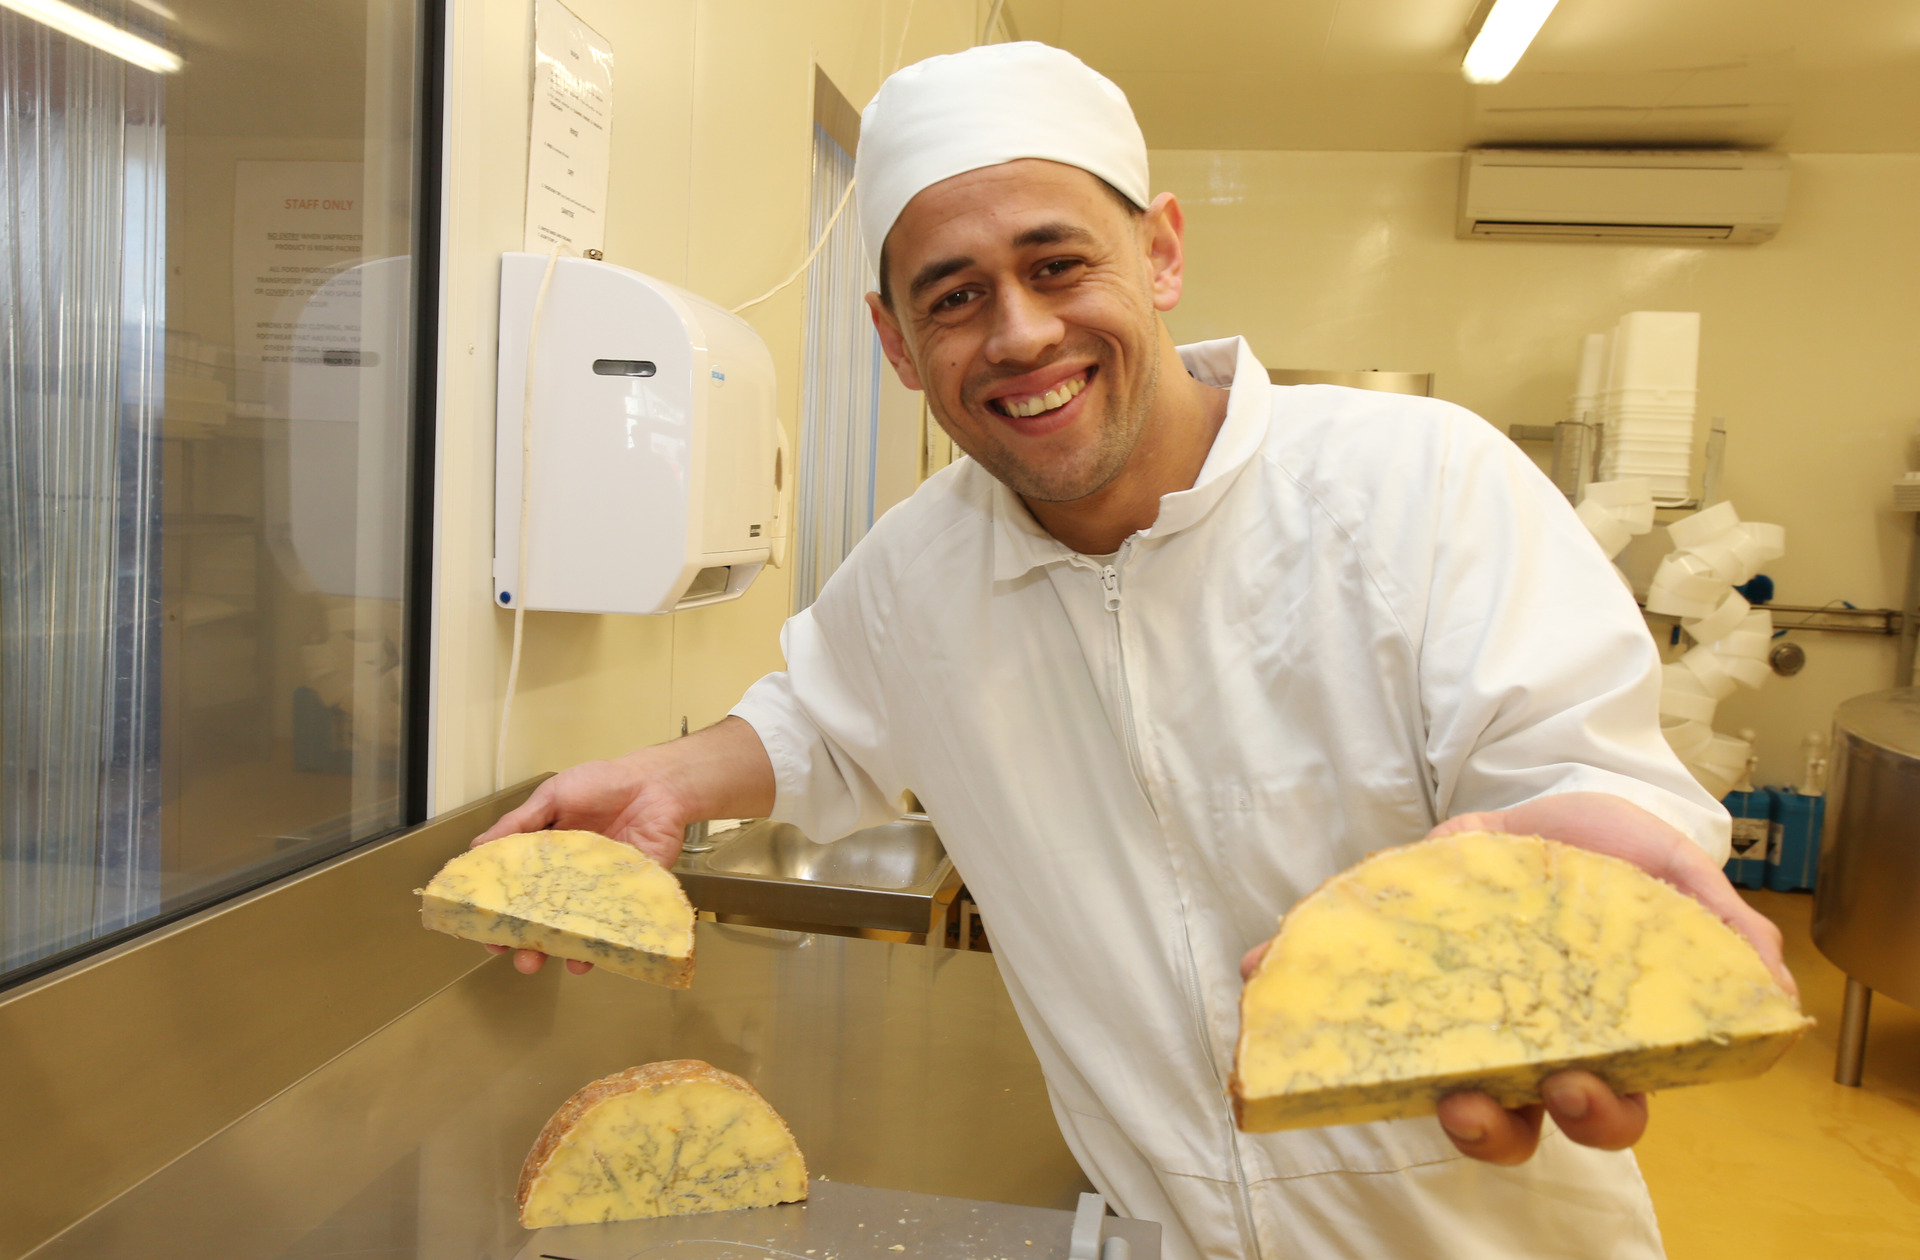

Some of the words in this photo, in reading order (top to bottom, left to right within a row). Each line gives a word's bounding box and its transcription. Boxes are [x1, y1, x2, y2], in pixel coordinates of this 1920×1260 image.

[285, 199, 319, 210] STAFF
[322, 200, 353, 211] ONLY
[267, 232, 277, 240] NO
[279, 233, 299, 241] ENTRY
[275, 243, 305, 251] PRODUCT
[314, 244, 334, 252] BEING
[301, 266, 335, 274] PRODUCTS
[256, 276, 302, 284] TRANSPORTED
[335, 290, 362, 298] SPILLAG
[305, 300, 328, 308] OCCUR
[283, 322, 293, 330] OR
[256, 332, 292, 340] FOOTWEAR
[293, 333, 310, 341] THAT
[281, 355, 289, 363] BE
[323, 357, 343, 365] PRIOR
[343, 357, 353, 365] TO
